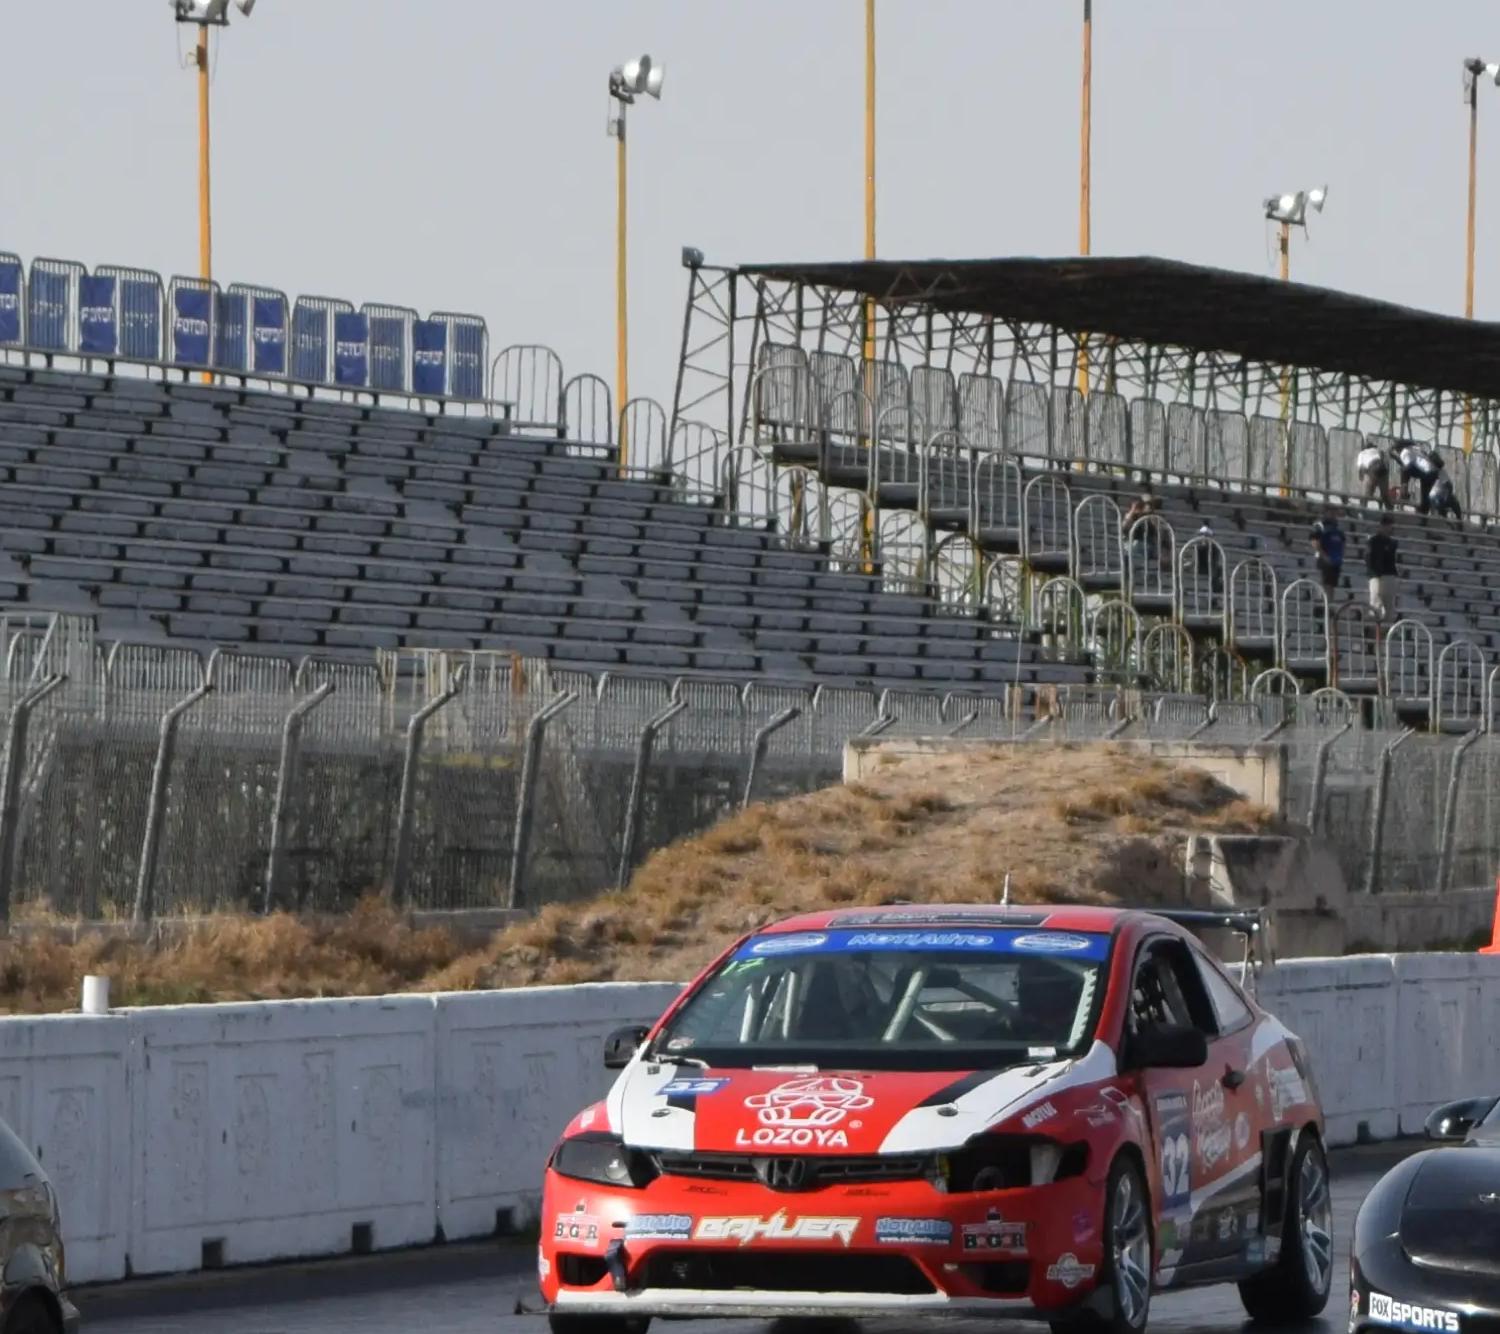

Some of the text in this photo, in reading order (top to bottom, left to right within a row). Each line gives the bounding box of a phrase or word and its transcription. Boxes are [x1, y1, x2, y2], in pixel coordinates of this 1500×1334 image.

[847, 932, 994, 947] NOTIAUTO
[735, 1127, 849, 1147] LOZOYA
[1160, 1132, 1190, 1197] 32
[877, 1217, 952, 1234] NOTIAUTO
[1371, 1295, 1460, 1332] FOX SPORTS
